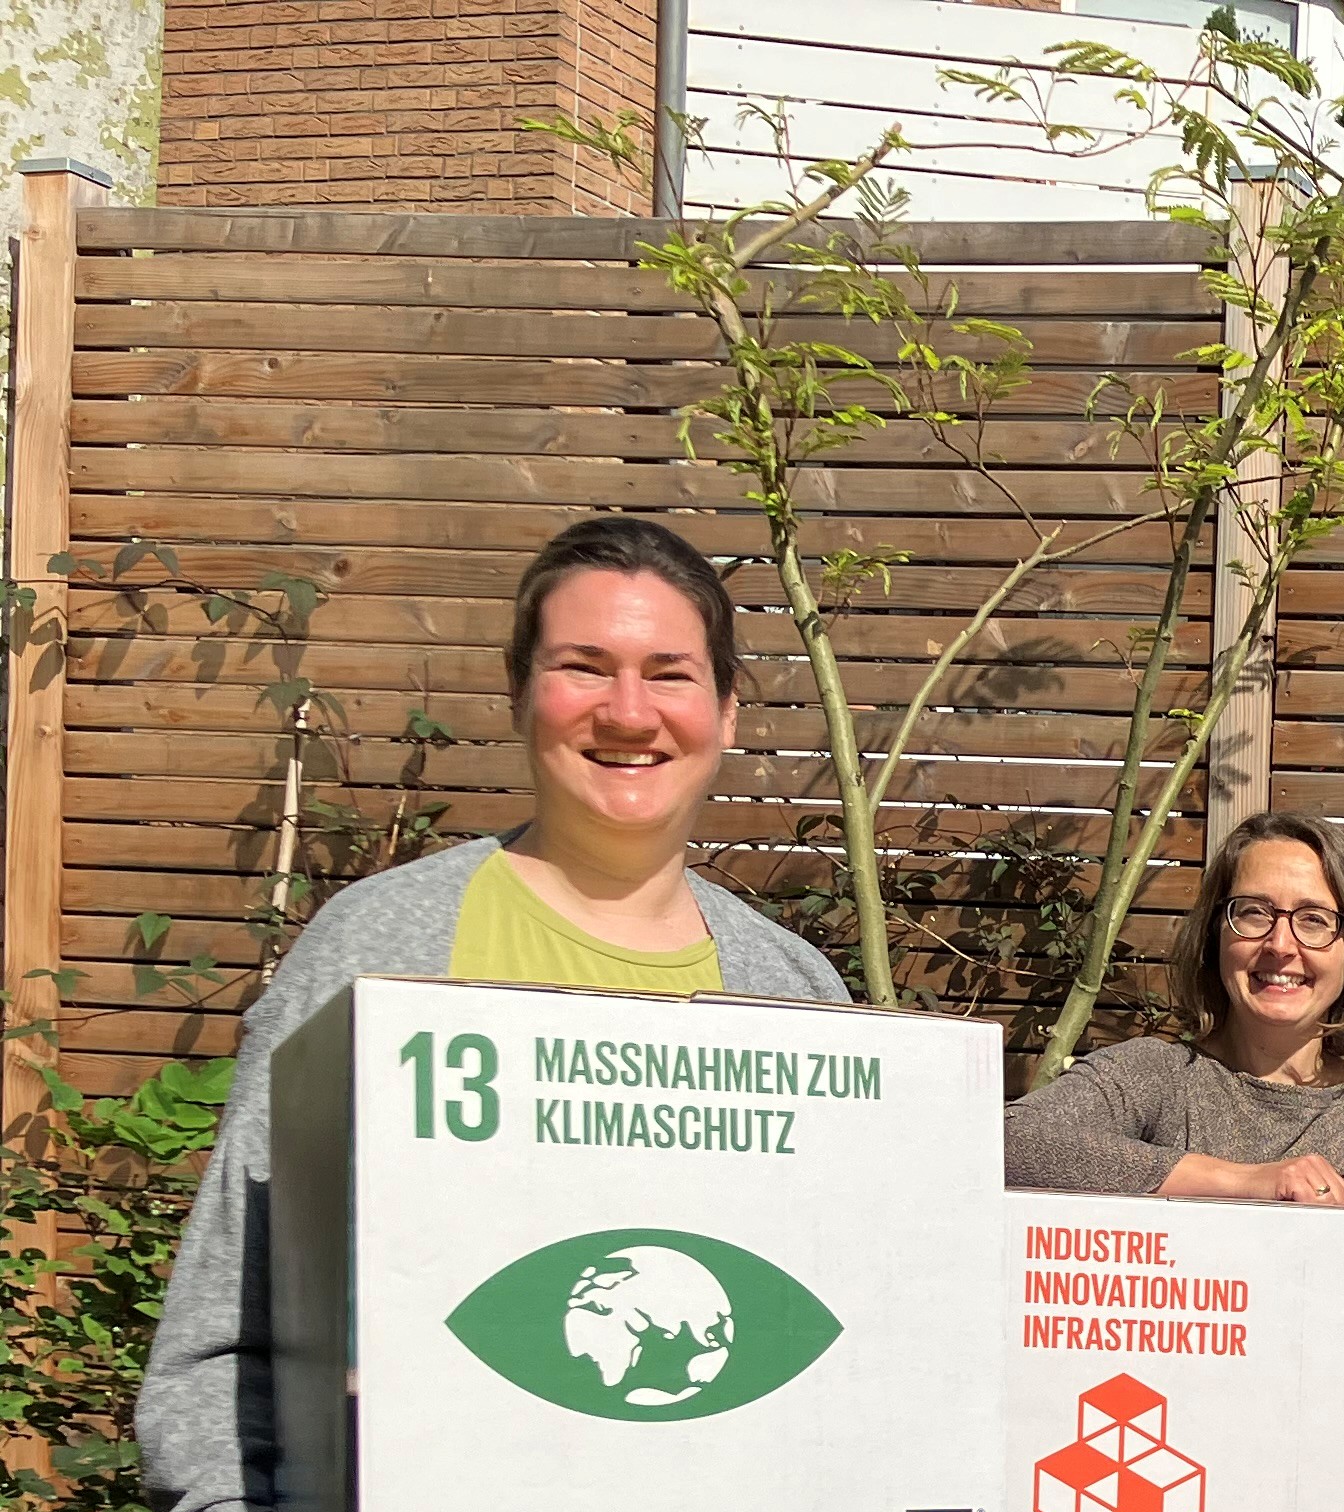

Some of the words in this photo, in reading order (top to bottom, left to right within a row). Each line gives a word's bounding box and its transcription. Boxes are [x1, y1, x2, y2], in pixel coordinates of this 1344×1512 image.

[400, 1031, 499, 1141] 13
[535, 1037, 798, 1096] MASSNAHMEN
[806, 1054, 881, 1100] ZUM
[535, 1099, 795, 1154] KLIMASCHUTZ
[1026, 1226, 1175, 1267] INDUSTRIE,
[1025, 1271, 1187, 1310] INNOVATION
[1193, 1279, 1248, 1313] UND
[1023, 1315, 1246, 1356] INFRASTRUKTUR
